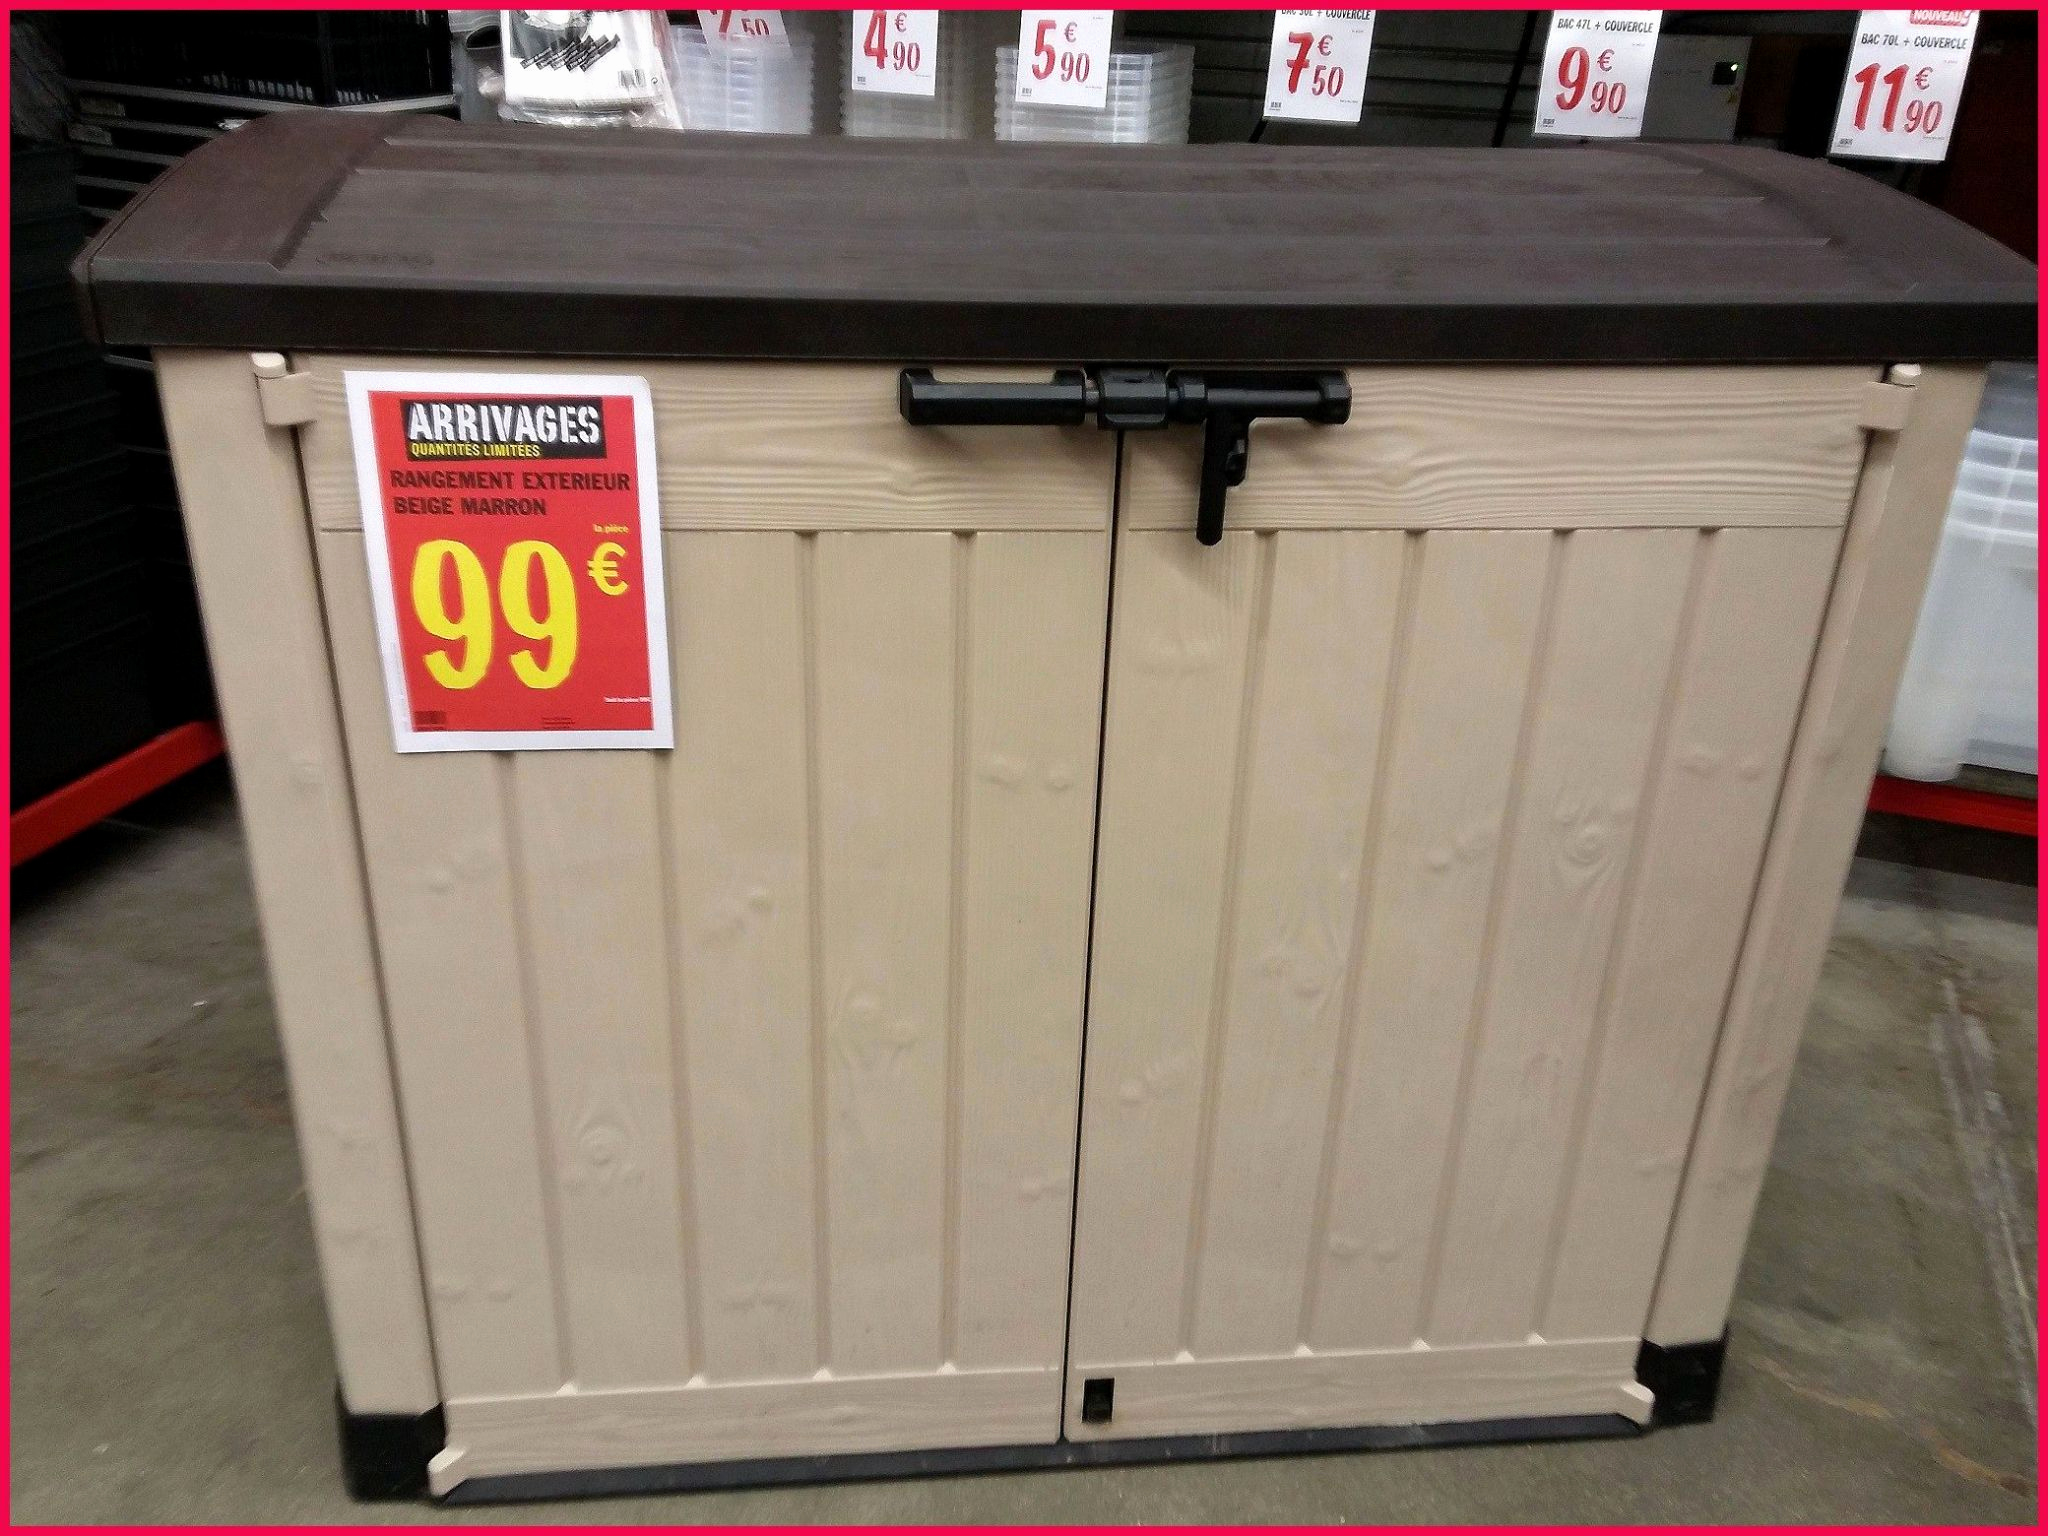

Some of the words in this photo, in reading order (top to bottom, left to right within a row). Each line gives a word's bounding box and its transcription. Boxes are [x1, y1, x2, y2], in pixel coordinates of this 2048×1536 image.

[863, 9, 888, 70] 4
[893, 41, 920, 71] 90
[1032, 20, 1057, 80] 5
[1061, 52, 1090, 83] 90
[1557, 18, 1574, 29] BAC
[1576, 18, 1591, 30] 47L
[1604, 20, 1654, 33] COUVERCLE
[1861, 33, 1880, 46] BAC
[1882, 34, 1899, 46] 70L
[1914, 36, 1969, 50] COUVERCLE
[1286, 31, 1315, 94] 7
[1311, 65, 1344, 97] 50
[1556, 46, 1590, 111] 9
[1590, 81, 1627, 114] 90
[1854, 62, 1910, 133] 11
[1904, 100, 1943, 134] 90
[408, 402, 600, 445] ARRIVAGES
[411, 442, 480, 457] QUANTITÉS
[483, 442, 541, 458] LIMITÉES
[390, 470, 515, 490] RANGEMENT
[523, 472, 631, 491] EXTERIEUR
[393, 496, 454, 515] BEIGE
[461, 497, 547, 516] MARRON
[411, 539, 578, 690] 99
[587, 541, 629, 596] €
